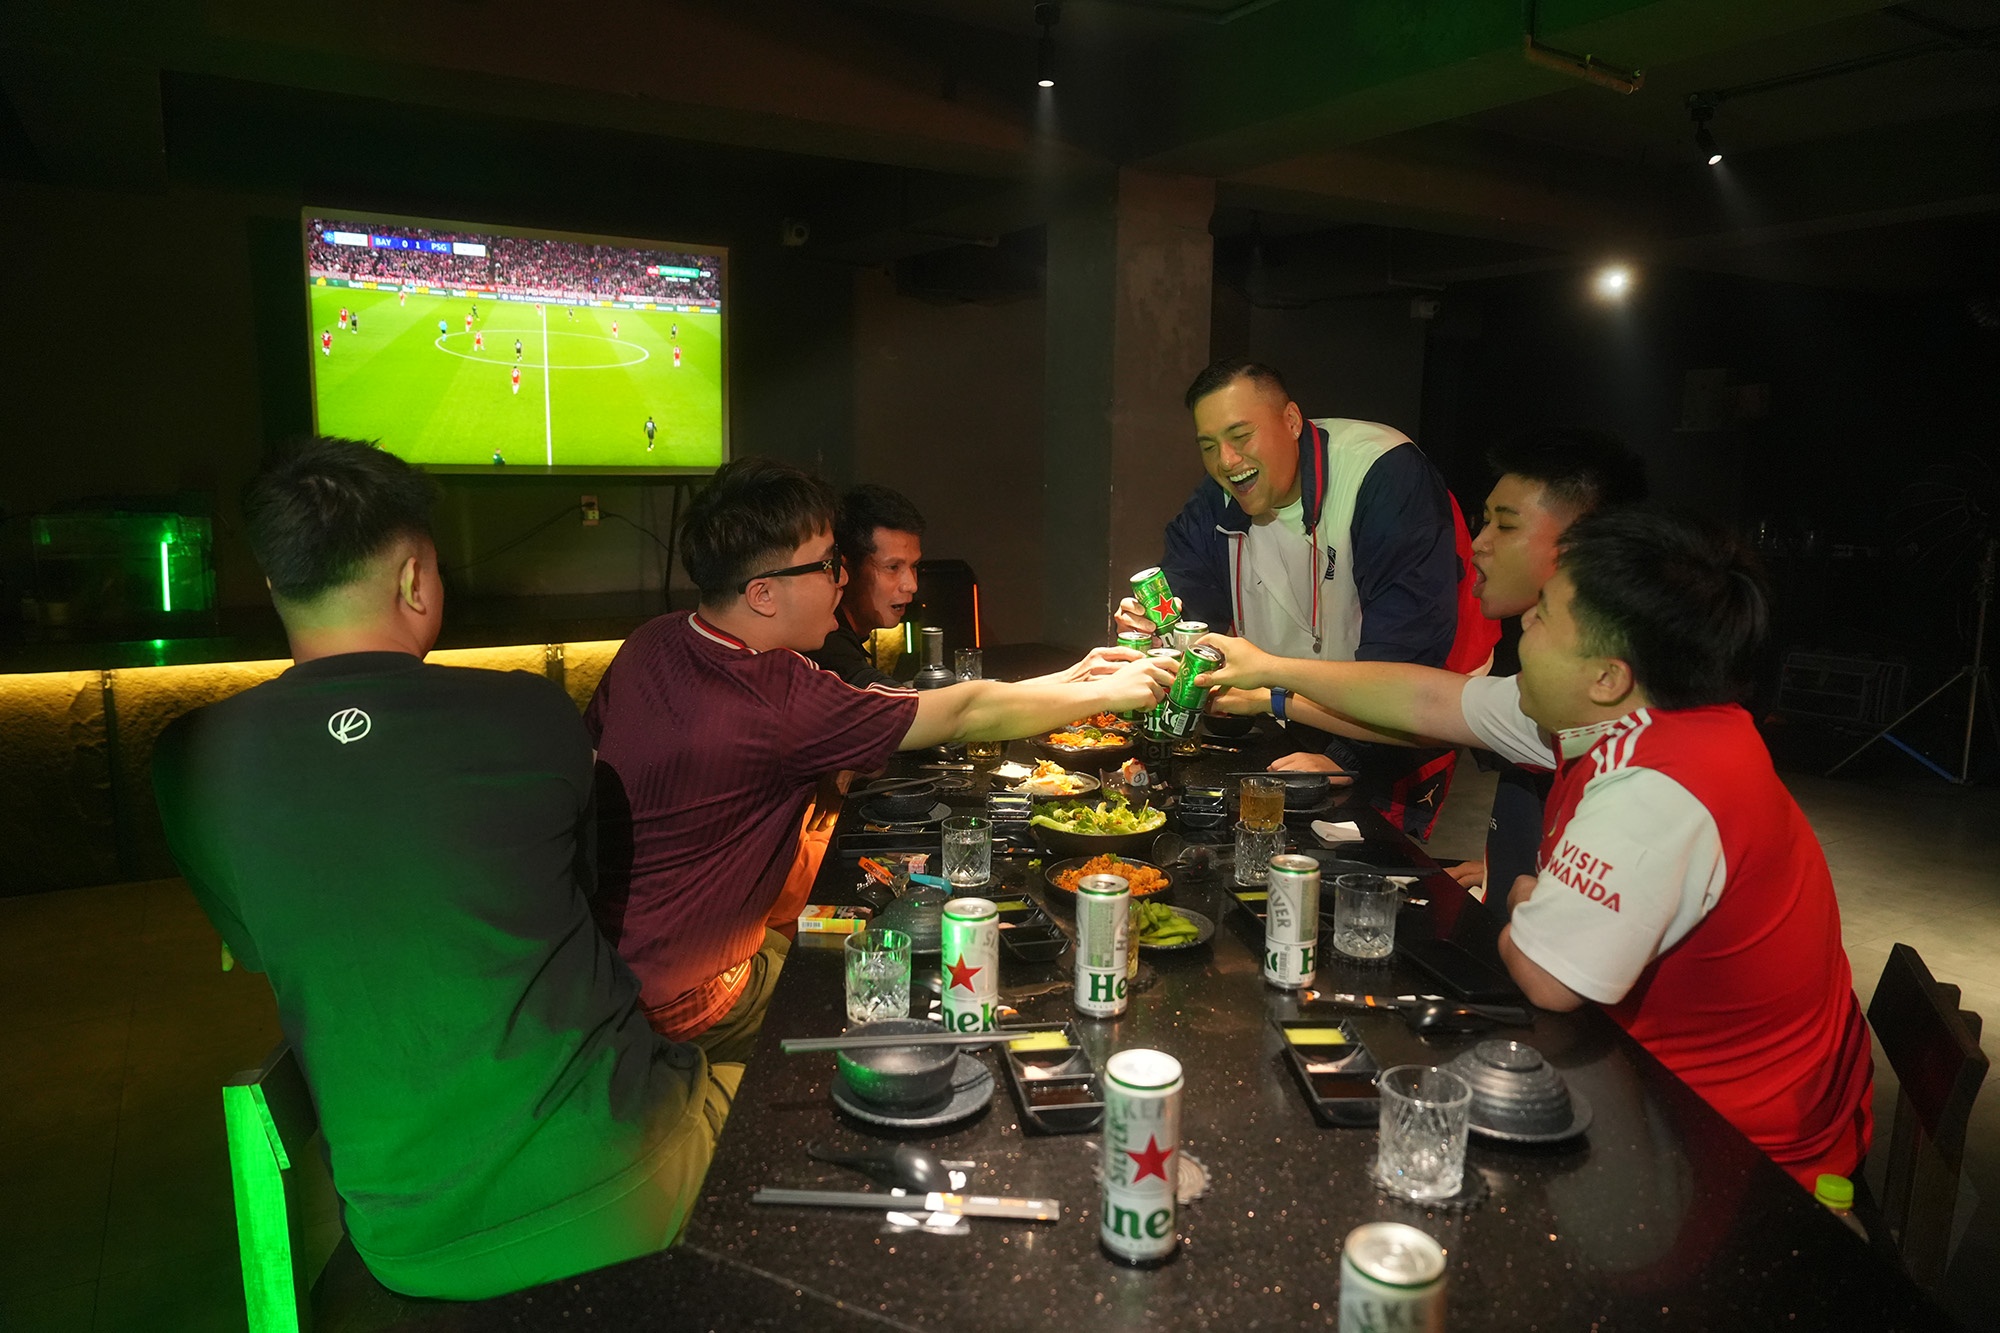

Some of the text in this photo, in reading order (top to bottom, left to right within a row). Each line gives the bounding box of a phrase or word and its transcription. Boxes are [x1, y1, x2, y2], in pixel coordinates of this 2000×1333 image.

[375, 238, 391, 246] BAY
[401, 240, 409, 248] 0
[415, 241, 421, 249] 1
[431, 242, 447, 251] PSG
[1562, 840, 1613, 880] VISIT
